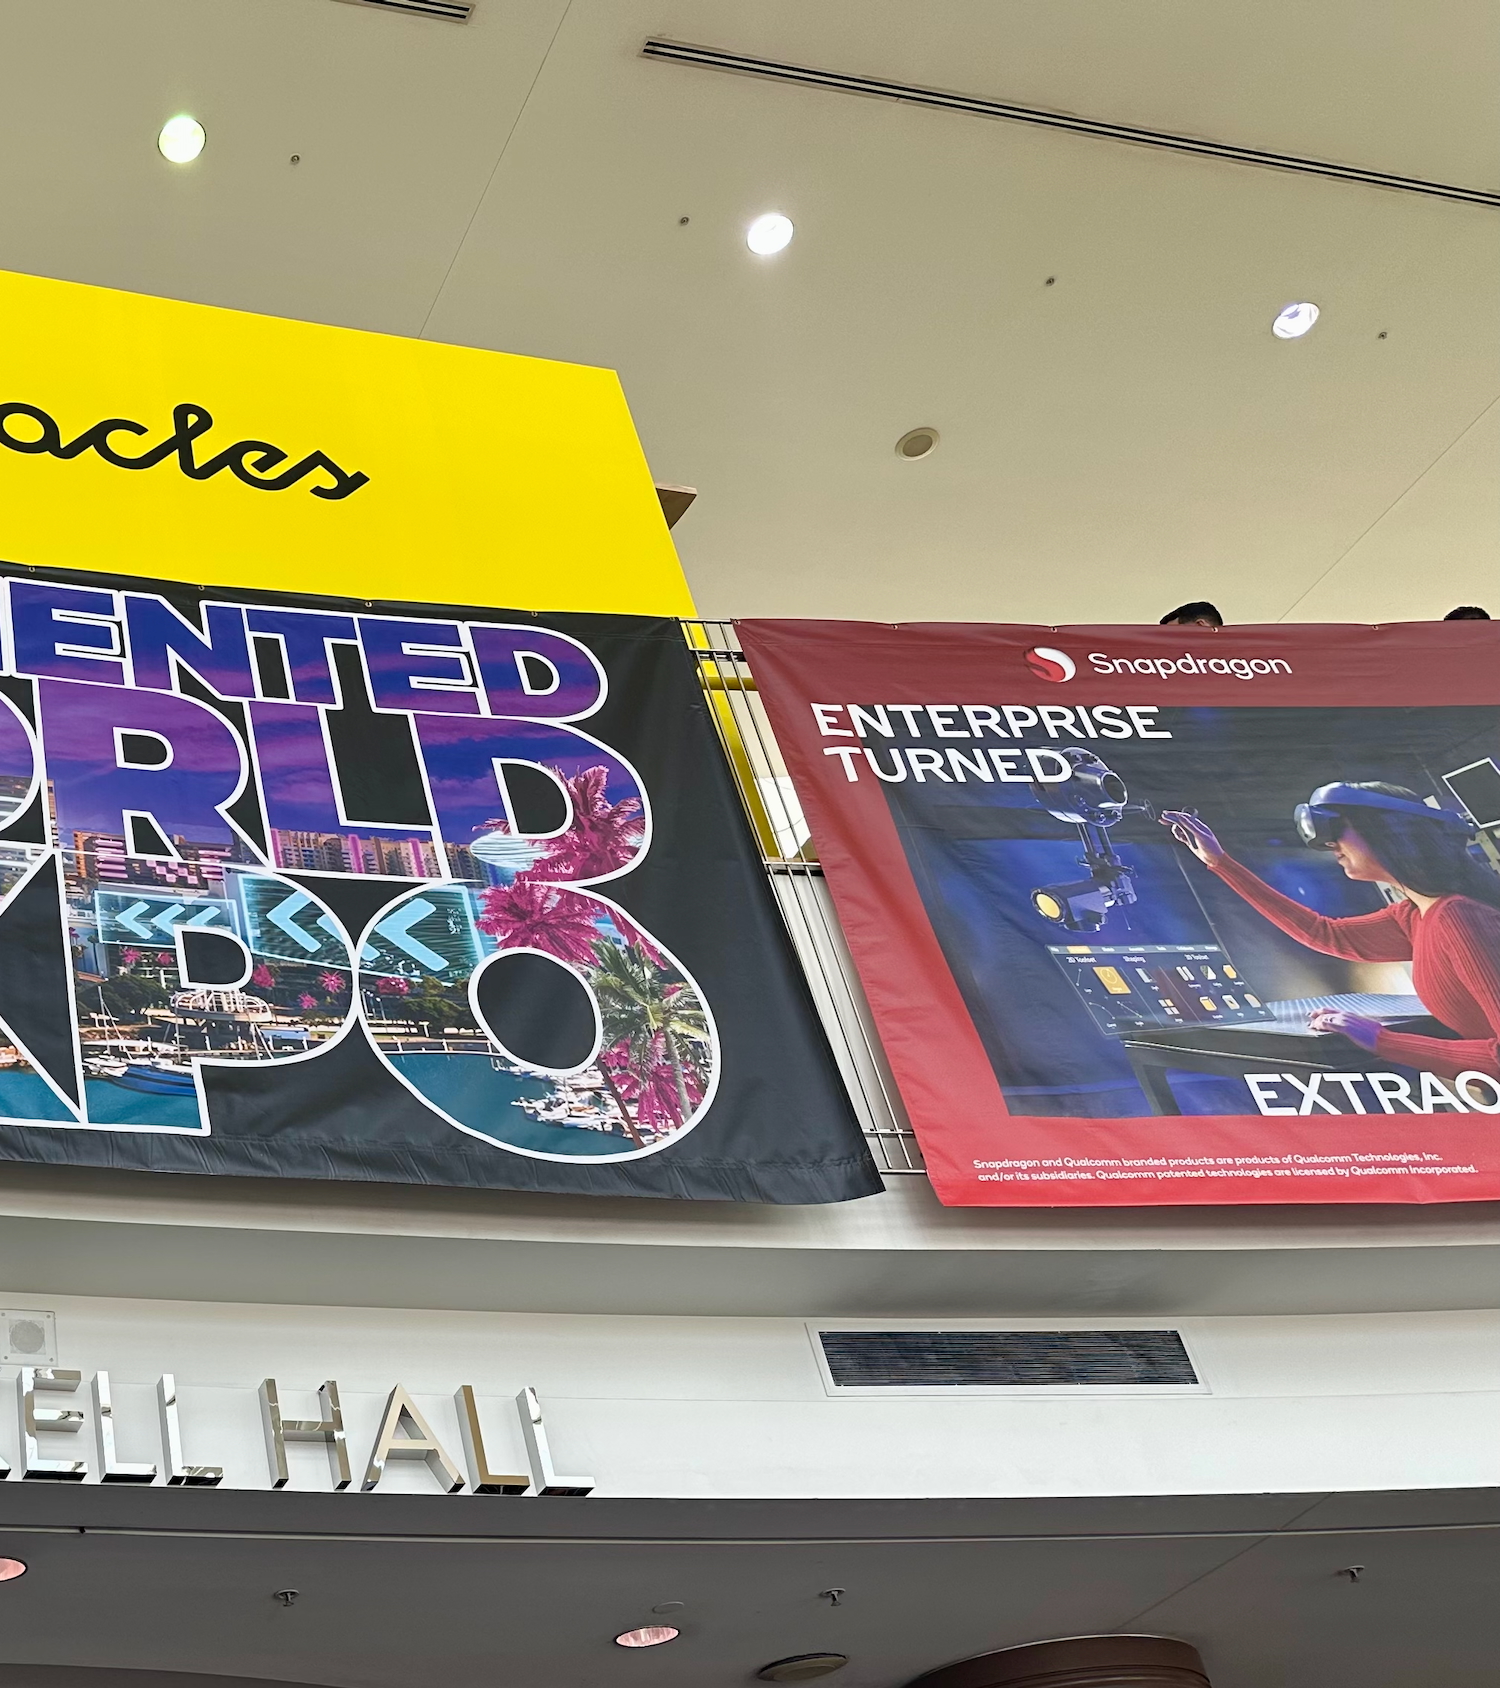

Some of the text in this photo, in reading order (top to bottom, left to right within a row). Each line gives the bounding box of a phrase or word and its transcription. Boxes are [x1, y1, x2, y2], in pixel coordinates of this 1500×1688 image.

[1087, 652, 1293, 680] Snapdragon
[810, 702, 1173, 740] ENTERPRISE
[822, 746, 1074, 783] TURNED
[1243, 1070, 1500, 1116] EXTRAO
[973, 1152, 1443, 1170] Snapdragon and Qualcomm branded products are products of Qualcomm Technologies, Inc.
[978, 1164, 1479, 1182] and/or its subsidiaries. Qualcomm patented technologies are licensed by Qualcomm Incorporated.
[258, 1377, 595, 1496] HALL
